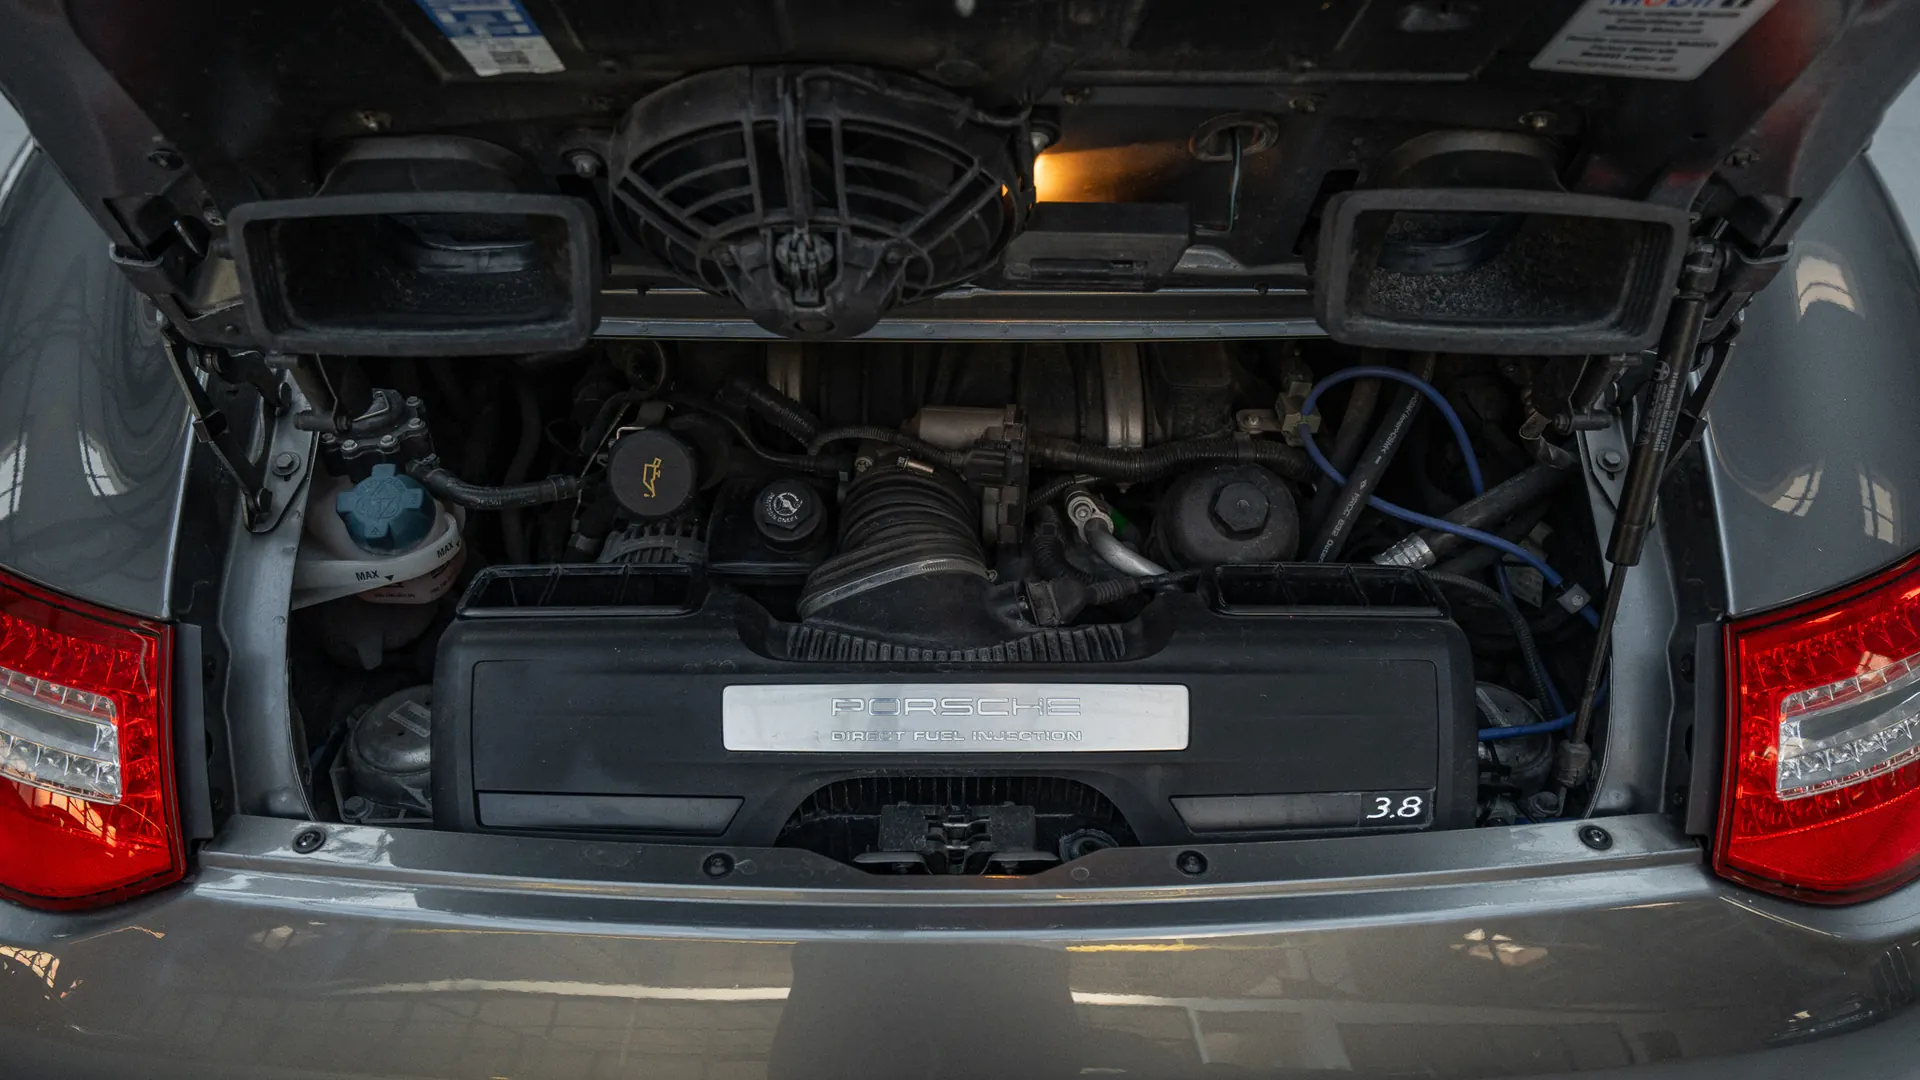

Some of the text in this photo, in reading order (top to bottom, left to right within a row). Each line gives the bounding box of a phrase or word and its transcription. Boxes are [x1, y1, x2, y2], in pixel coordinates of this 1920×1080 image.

[436, 541, 454, 558] MAX
[355, 570, 380, 582] MAX
[830, 697, 1083, 717] PORSCHE
[830, 730, 1083, 742] DIRECT FUEL INJECTION
[1366, 796, 1423, 819] 3.8
